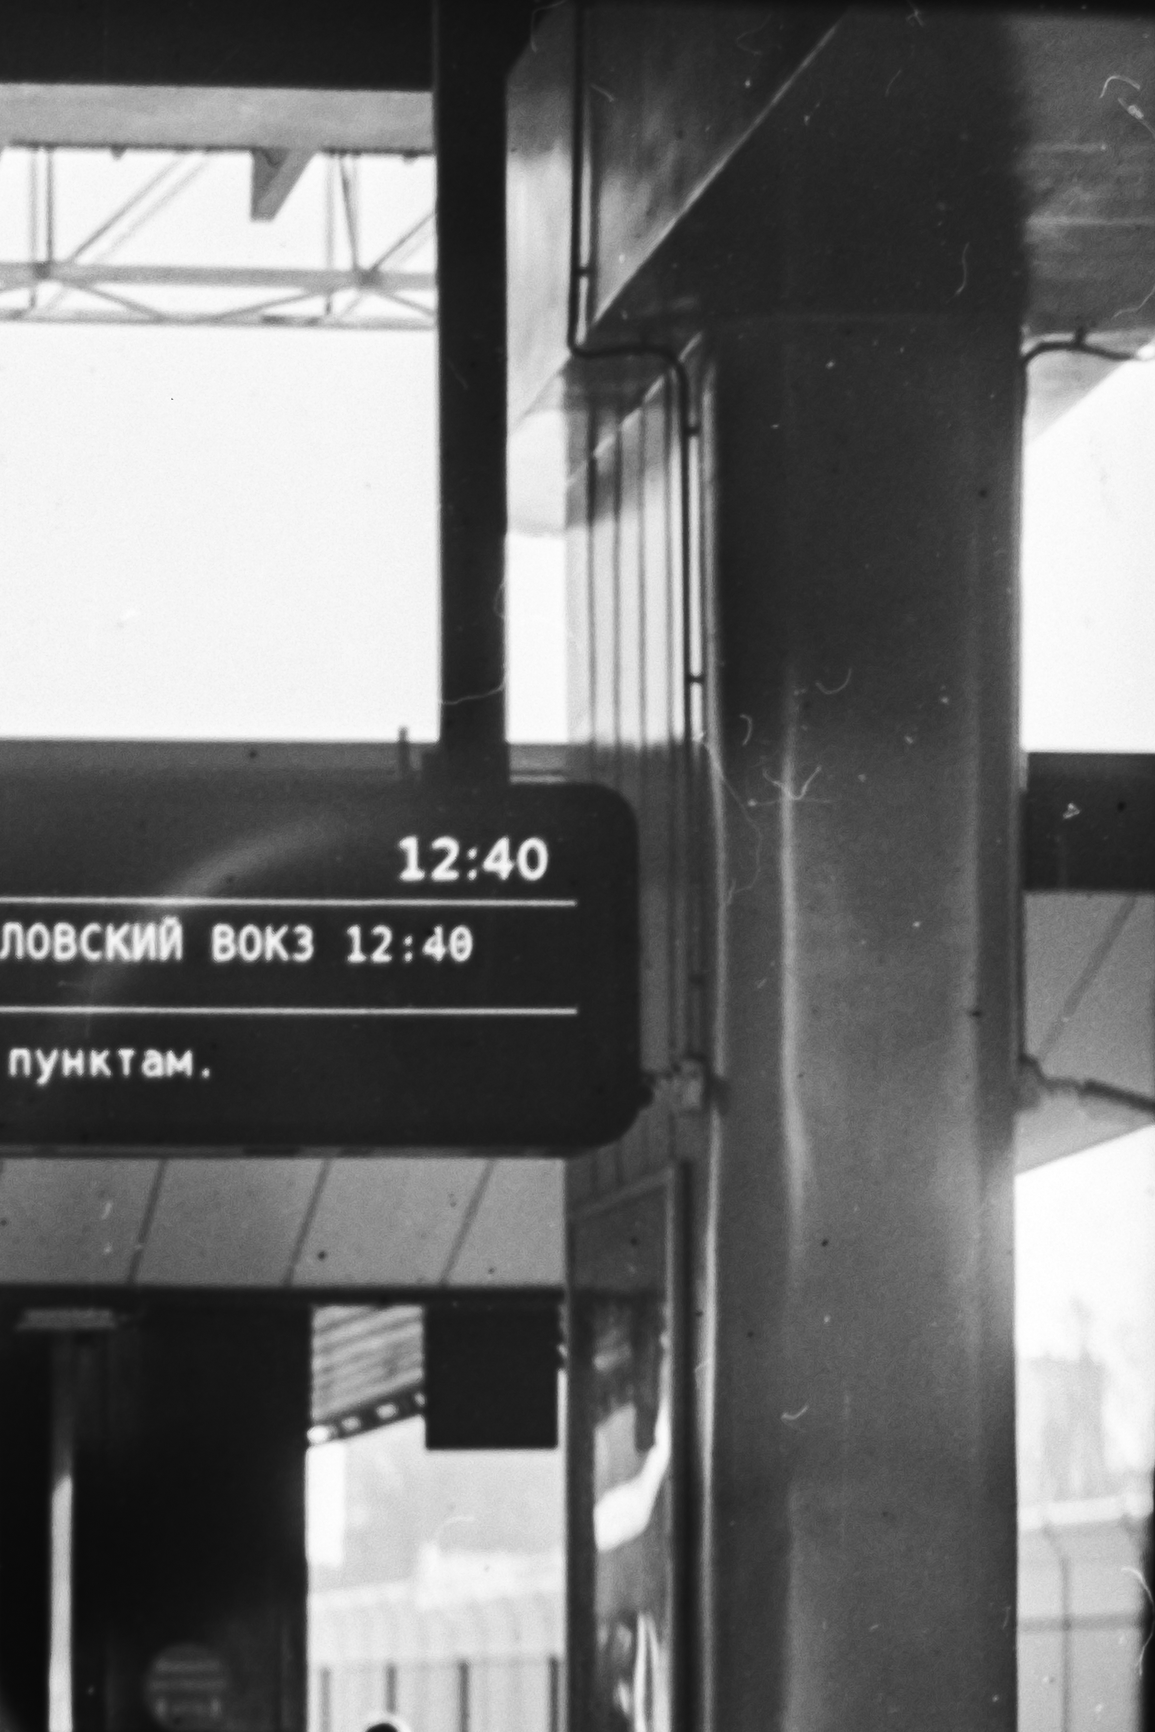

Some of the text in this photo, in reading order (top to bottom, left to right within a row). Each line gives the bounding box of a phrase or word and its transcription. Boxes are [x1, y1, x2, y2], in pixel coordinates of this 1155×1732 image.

[398, 835, 549, 882] 12:40
[346, 924, 474, 963] 12:40
[8, 1047, 211, 1086] пунктам.
